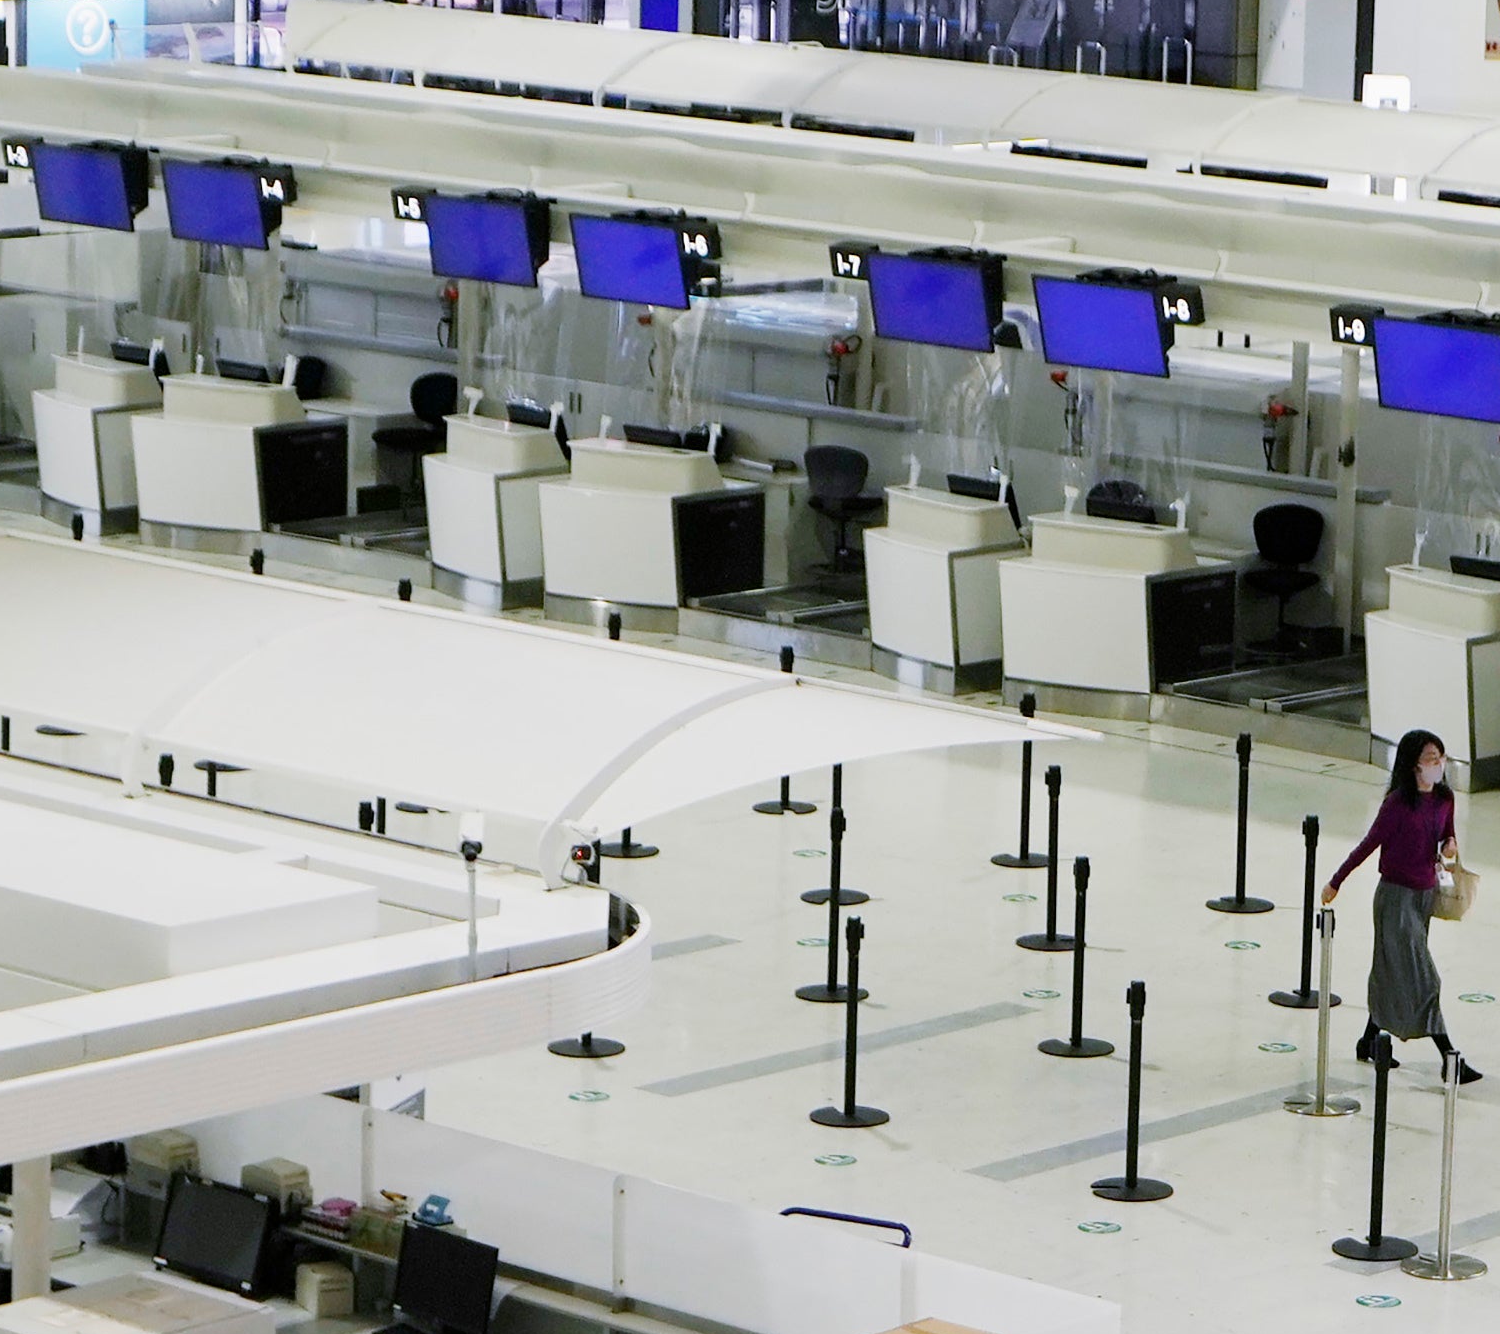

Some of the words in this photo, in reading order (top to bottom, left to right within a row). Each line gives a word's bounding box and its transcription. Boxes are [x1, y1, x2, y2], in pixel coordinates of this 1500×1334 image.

[683, 232, 709, 257] I-6
[836, 252, 861, 277] I-7
[1162, 295, 1191, 322] I-8
[1337, 316, 1366, 343] I-9
